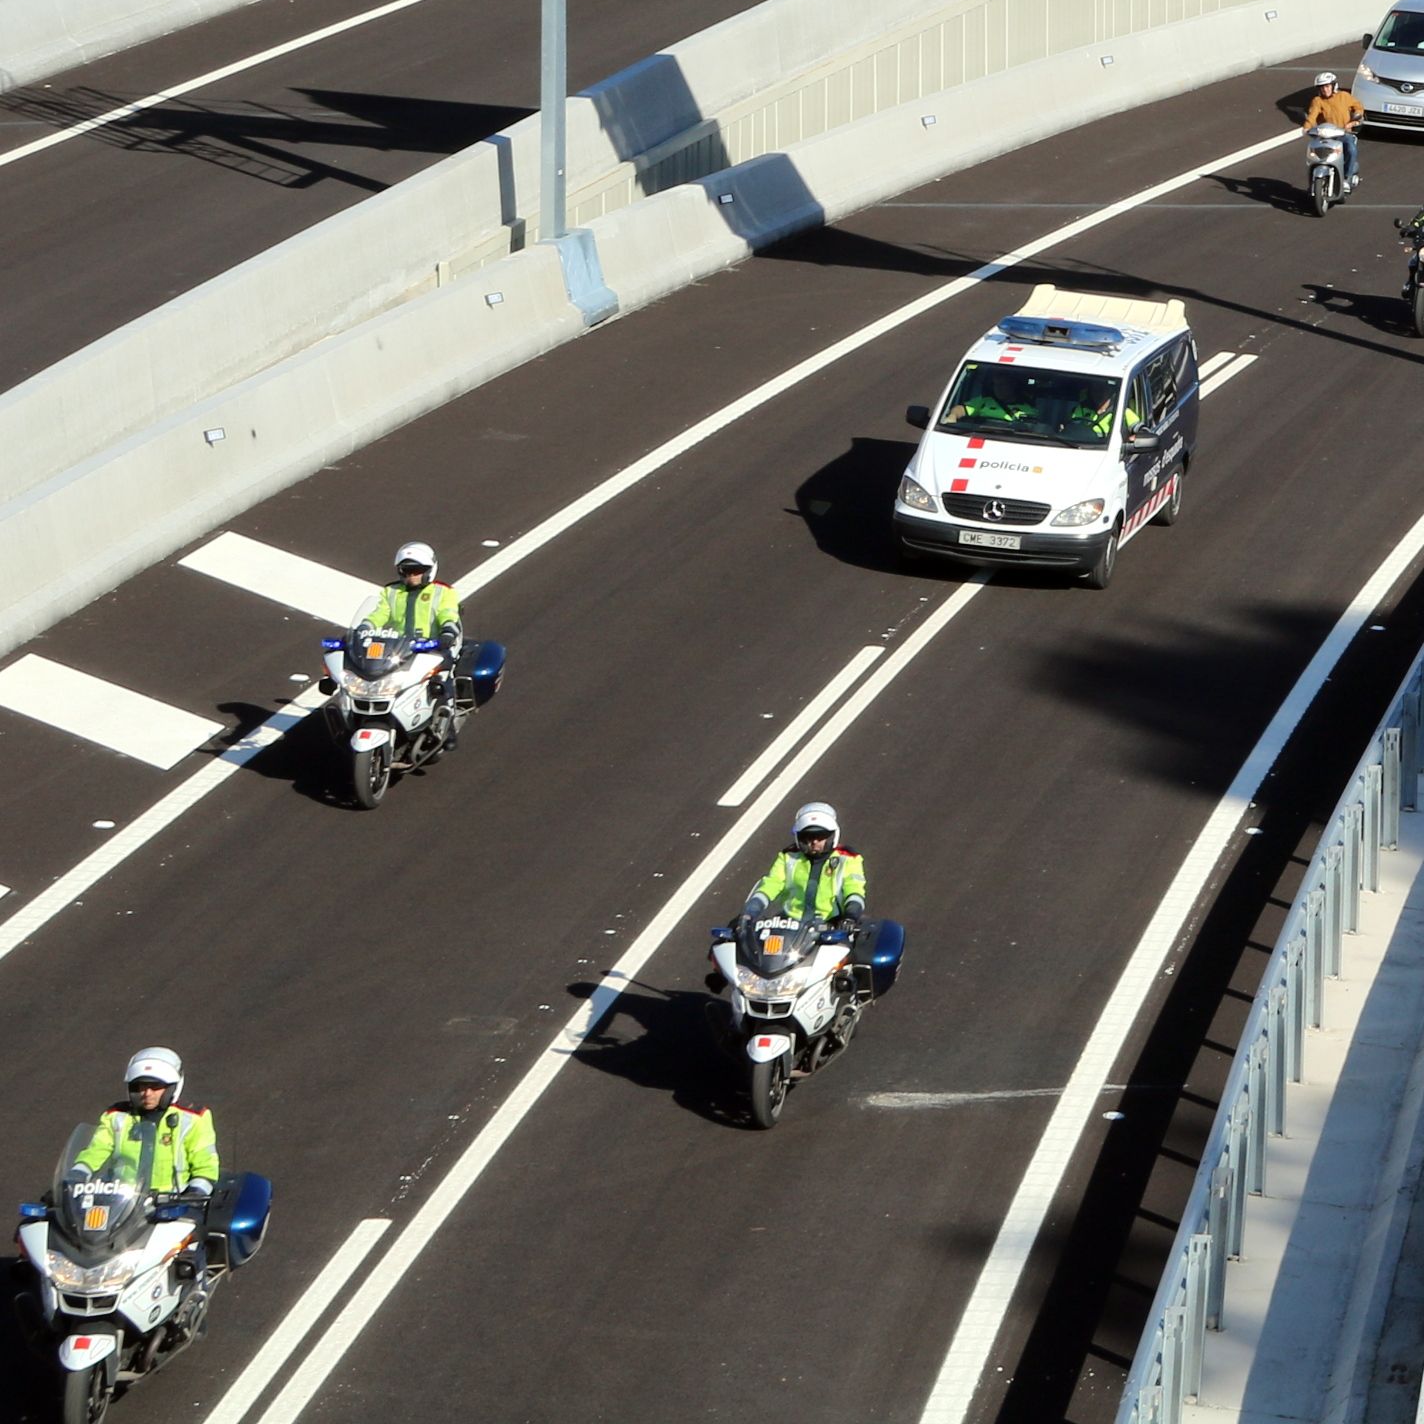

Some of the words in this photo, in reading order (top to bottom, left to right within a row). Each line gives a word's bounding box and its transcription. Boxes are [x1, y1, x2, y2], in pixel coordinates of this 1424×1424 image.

[980, 461, 1030, 473] policia
[963, 532, 983, 544] CME
[990, 536, 1016, 548] 3372
[360, 626, 399, 639] policia
[755, 916, 800, 932] policia
